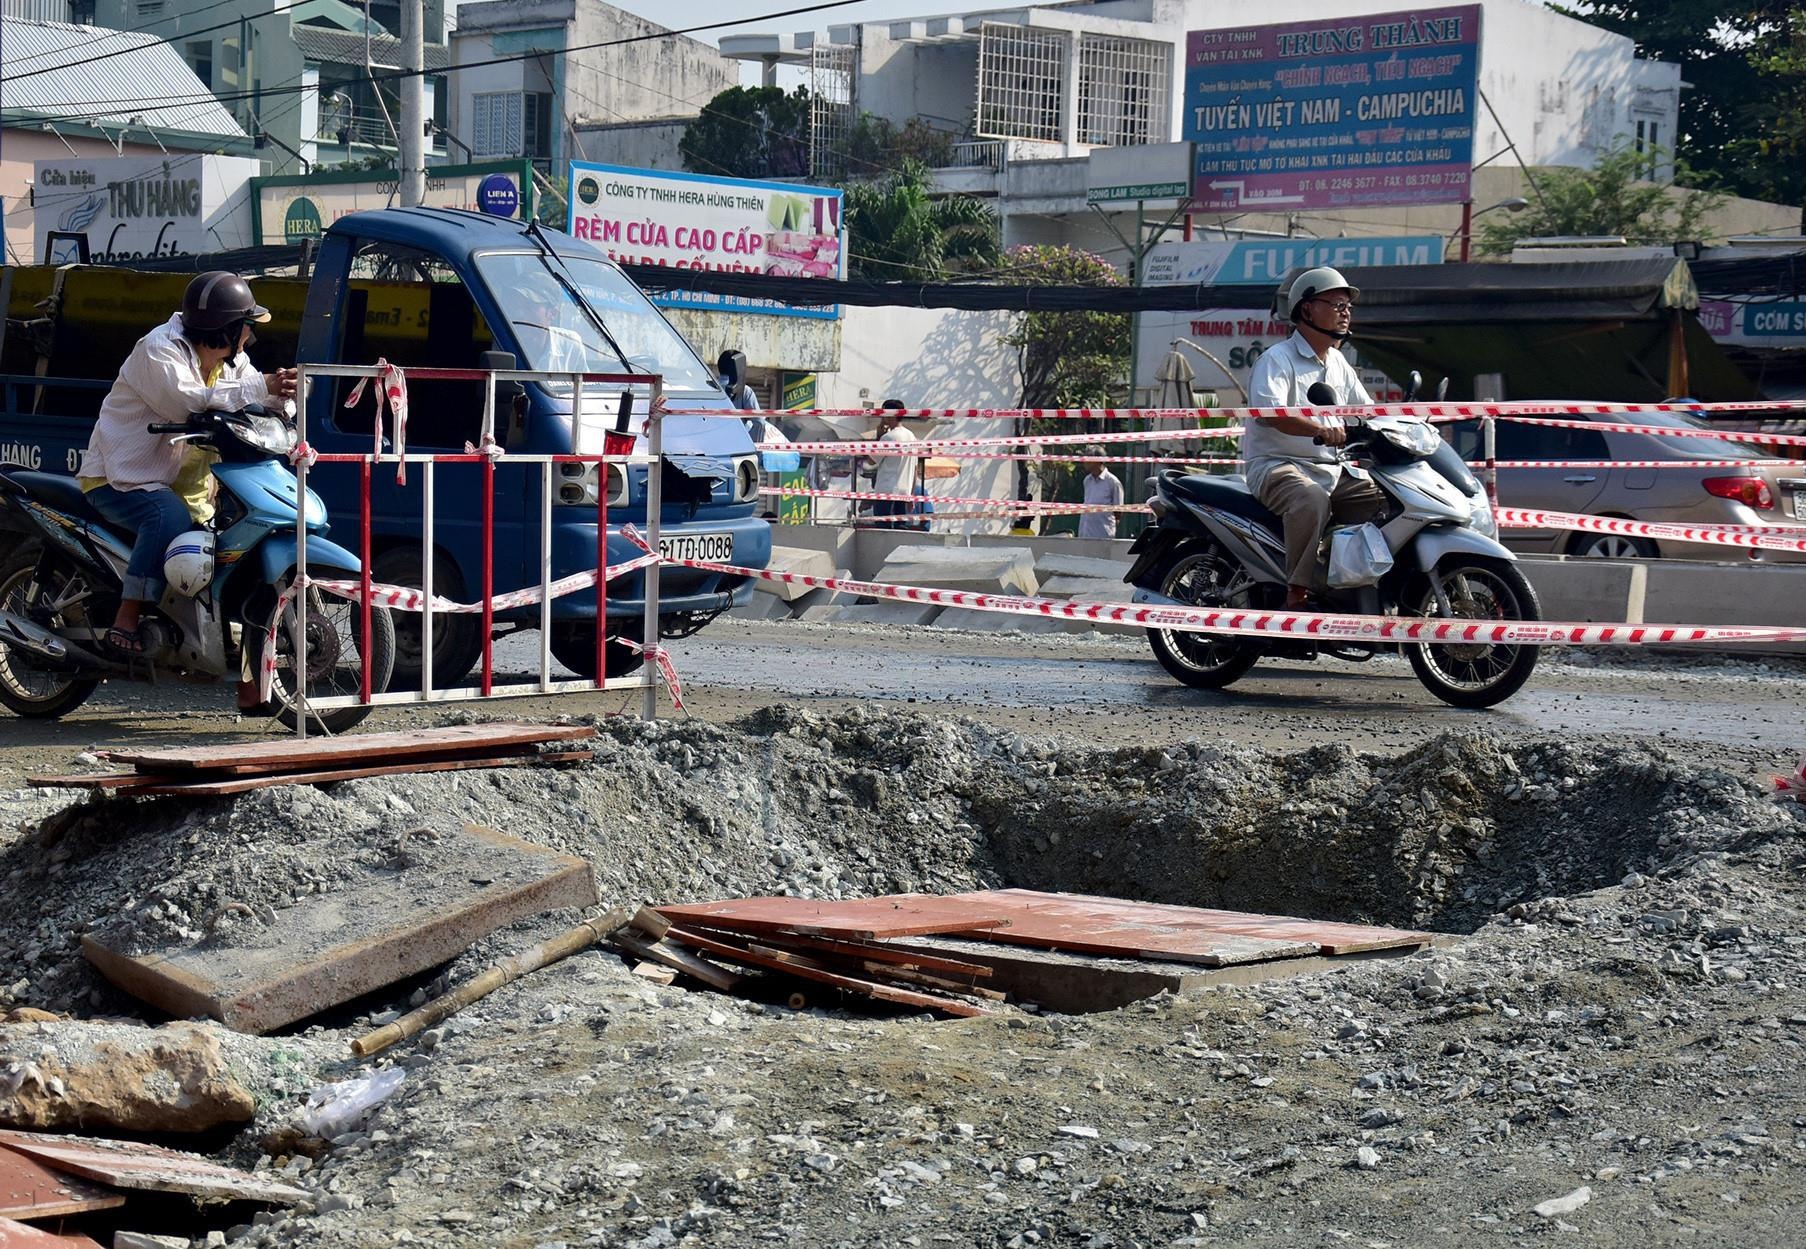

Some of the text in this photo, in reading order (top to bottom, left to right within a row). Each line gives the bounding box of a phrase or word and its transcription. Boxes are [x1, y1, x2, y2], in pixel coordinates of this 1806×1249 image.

[1203, 31, 1257, 45] CTY TNHH
[1276, 14, 1463, 57] TRUNG THÀNH
[1240, 47, 1263, 59] XNK
[1194, 95, 1250, 131] TUYẾN
[1255, 96, 1295, 132] VIỆT
[1301, 98, 1340, 125] NAM
[1358, 88, 1464, 121] CAMPUCHIA
[605, 181, 764, 211] CÔNG TY TNHH HERA HÙNG THIÊN
[1111, 188, 1127, 198] LAM
[287, 219, 320, 235] HERA
[574, 213, 763, 256] RÈM CỬA CAO CẤP
[1190, 320, 1233, 337] TRUNG
[1237, 317, 1263, 337] TÂM
[1754, 309, 1806, 331] CƠM S
[1, 440, 41, 469] HÀNG
